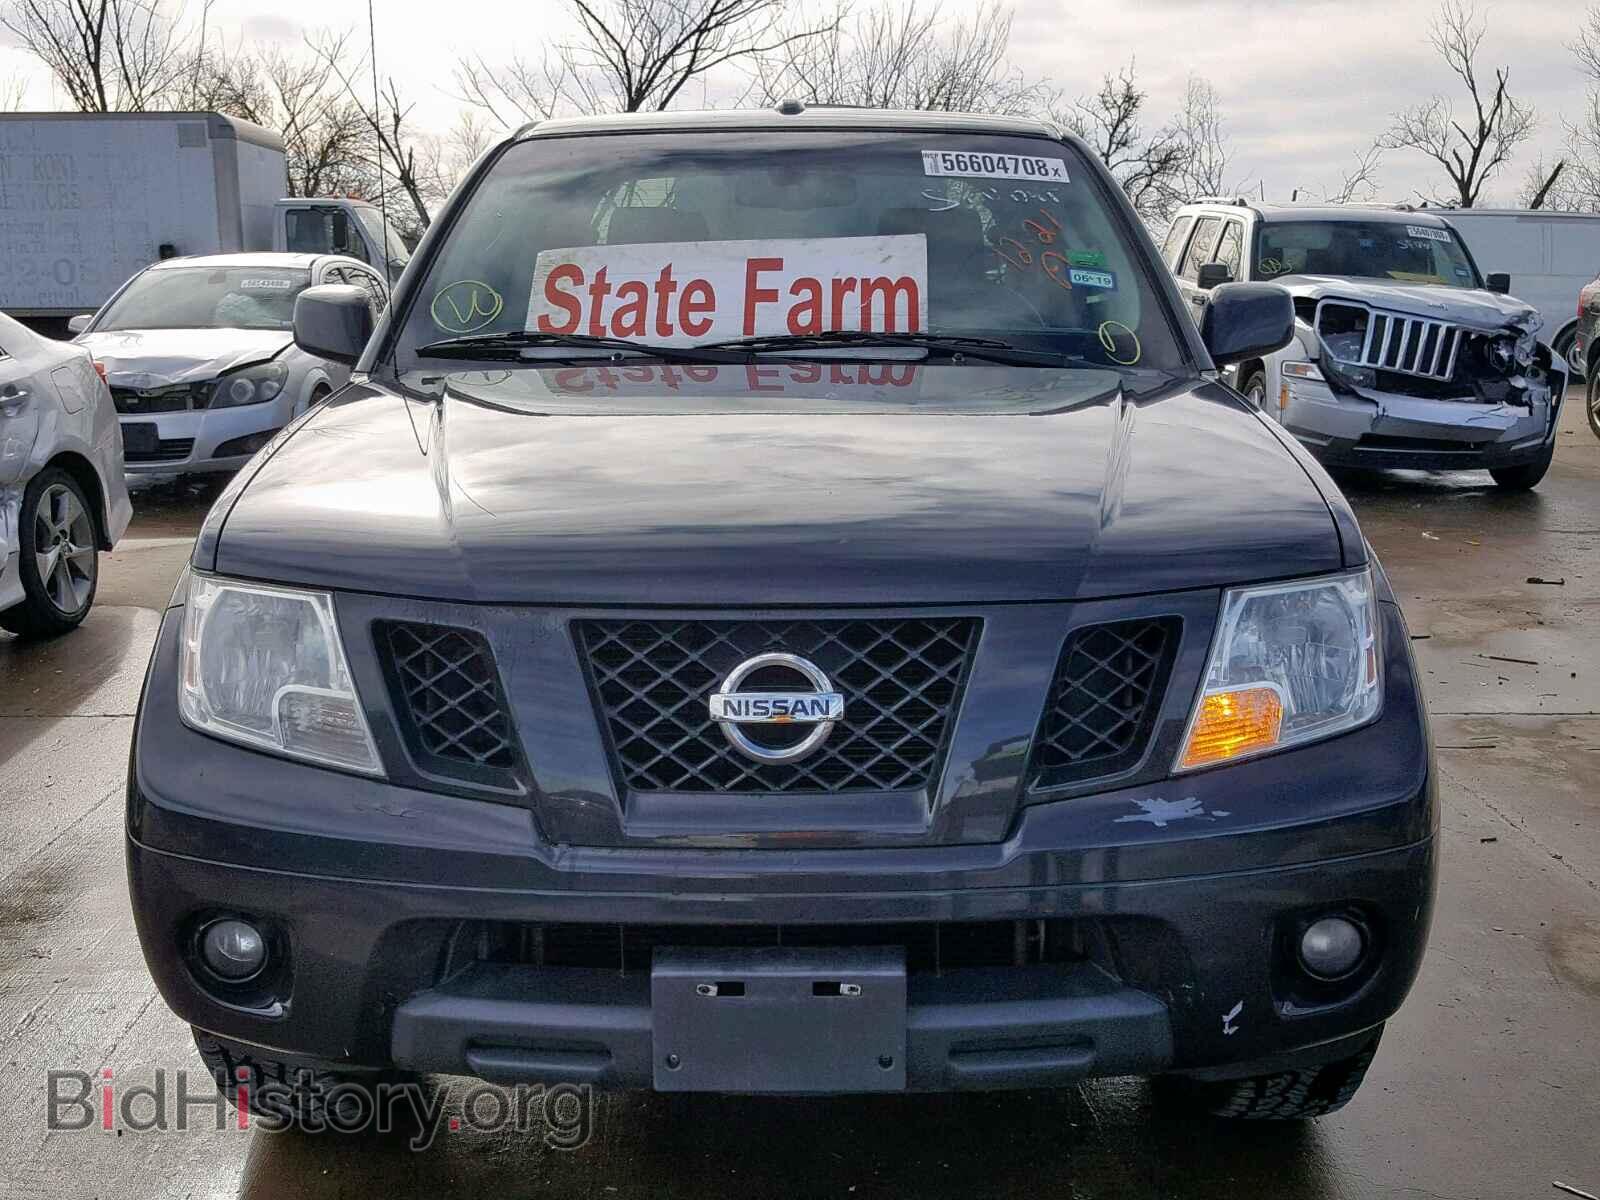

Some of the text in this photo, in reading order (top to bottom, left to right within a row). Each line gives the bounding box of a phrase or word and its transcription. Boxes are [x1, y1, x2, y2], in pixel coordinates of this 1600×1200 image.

[941, 153, 1050, 177] 56604708
[537, 256, 920, 338] State Farm
[722, 699, 830, 716] NISSAN
